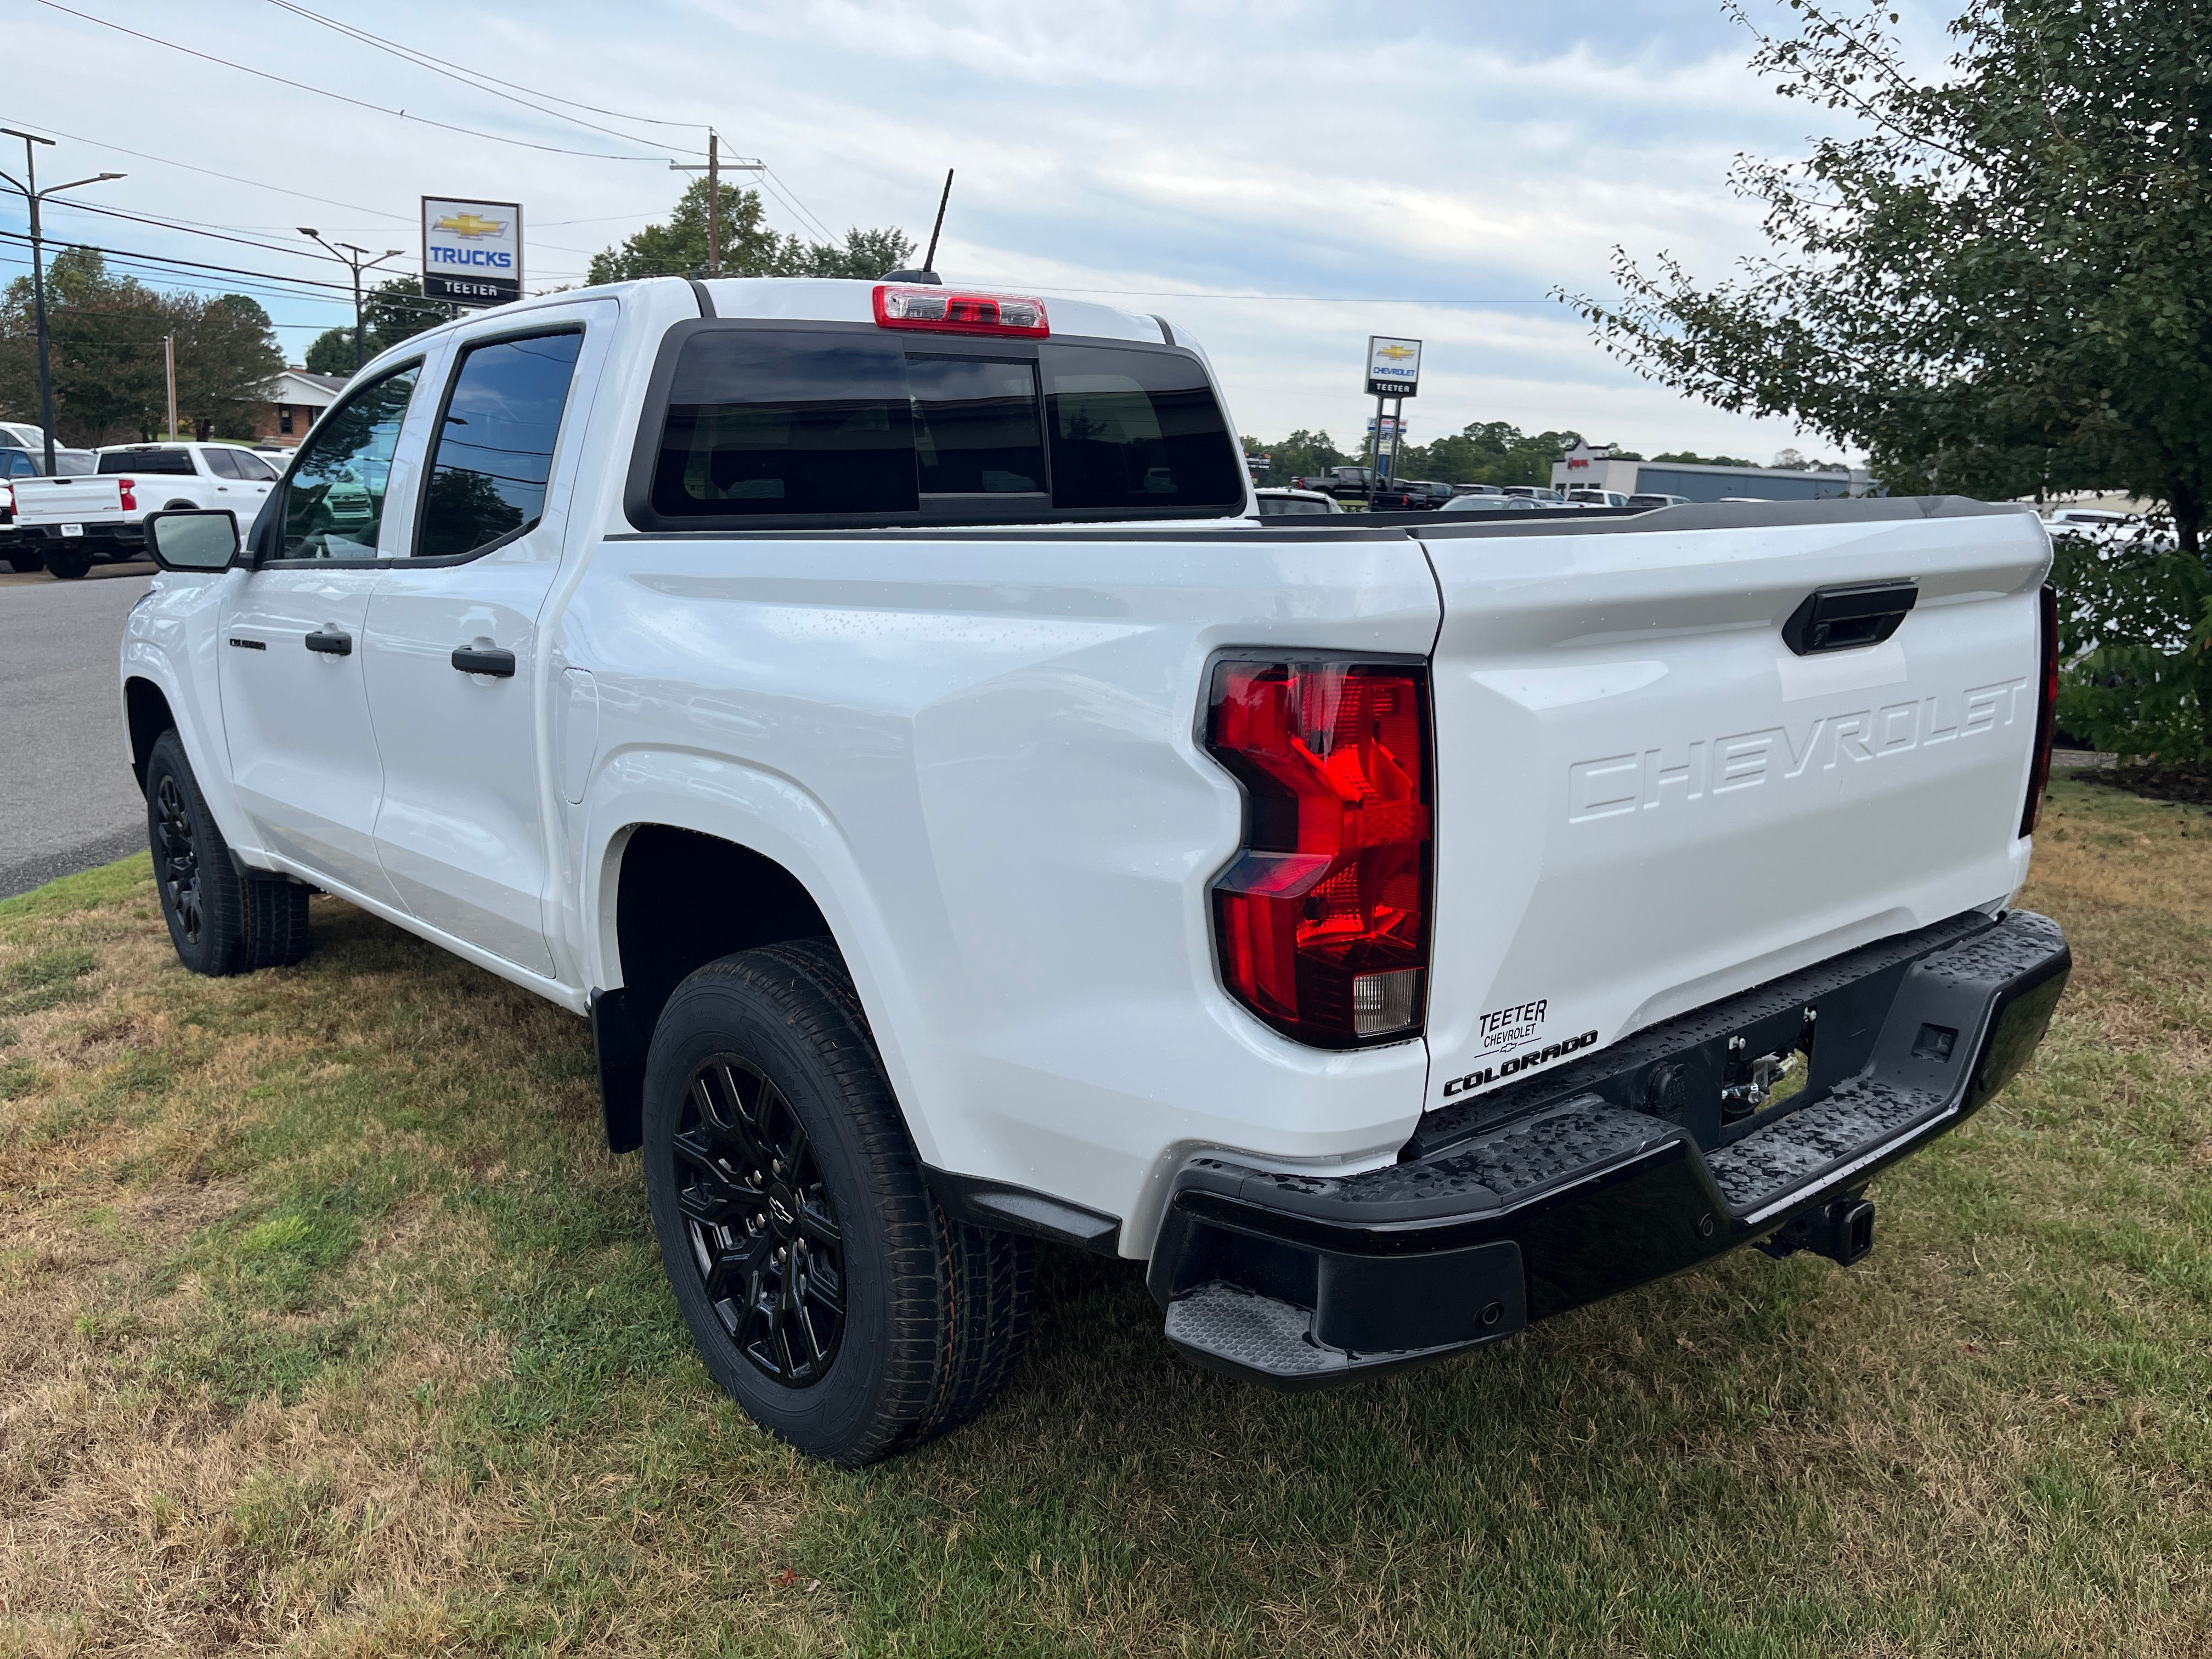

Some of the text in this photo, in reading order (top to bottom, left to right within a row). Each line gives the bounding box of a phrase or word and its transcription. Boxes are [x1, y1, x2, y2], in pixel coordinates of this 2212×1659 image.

[431, 247, 511, 267] TRUCKS
[445, 282, 498, 296] TEETER
[1373, 367, 1415, 376] CHEVROLET
[1376, 383, 1410, 392] TEETER
[1569, 676, 2028, 823] CHEVROLET
[1480, 998, 1548, 1038] TEETER
[1483, 1023, 1537, 1048] CHEVROLET
[1443, 1029, 1599, 1097] COLORADO
